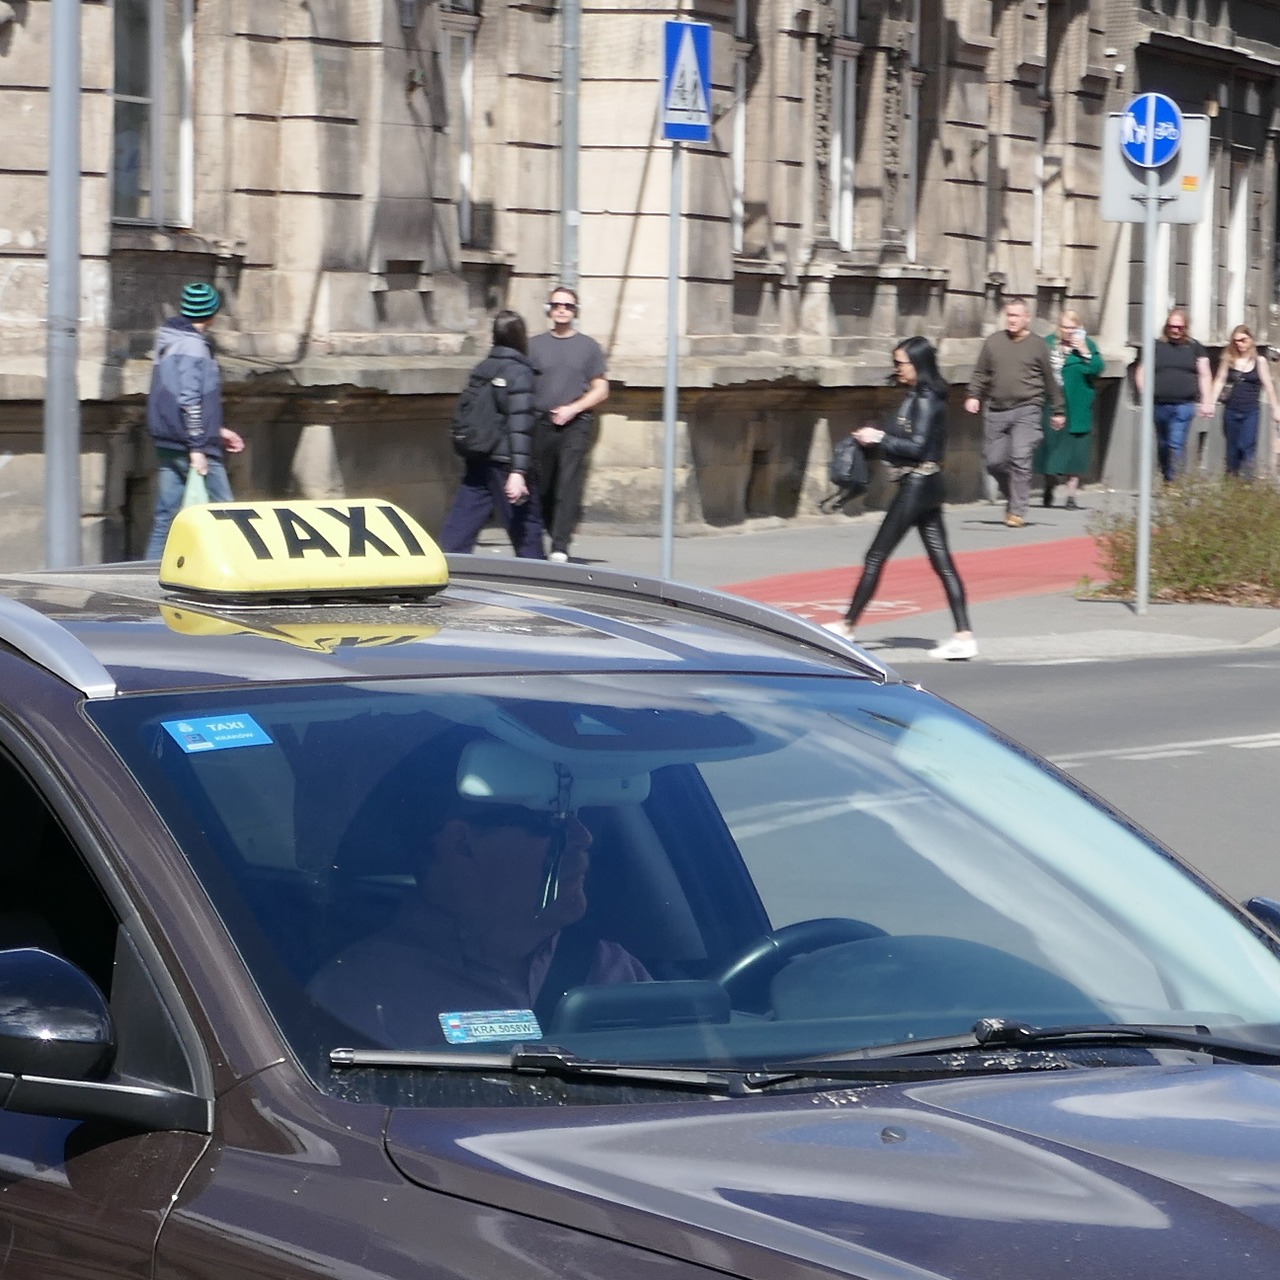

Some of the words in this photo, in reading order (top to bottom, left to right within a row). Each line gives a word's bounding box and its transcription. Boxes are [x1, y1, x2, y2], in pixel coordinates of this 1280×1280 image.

[208, 506, 426, 560] TAXI
[206, 721, 245, 732] TAXI
[472, 1024, 496, 1035] KRA
[499, 1023, 532, 1033] 5058W
